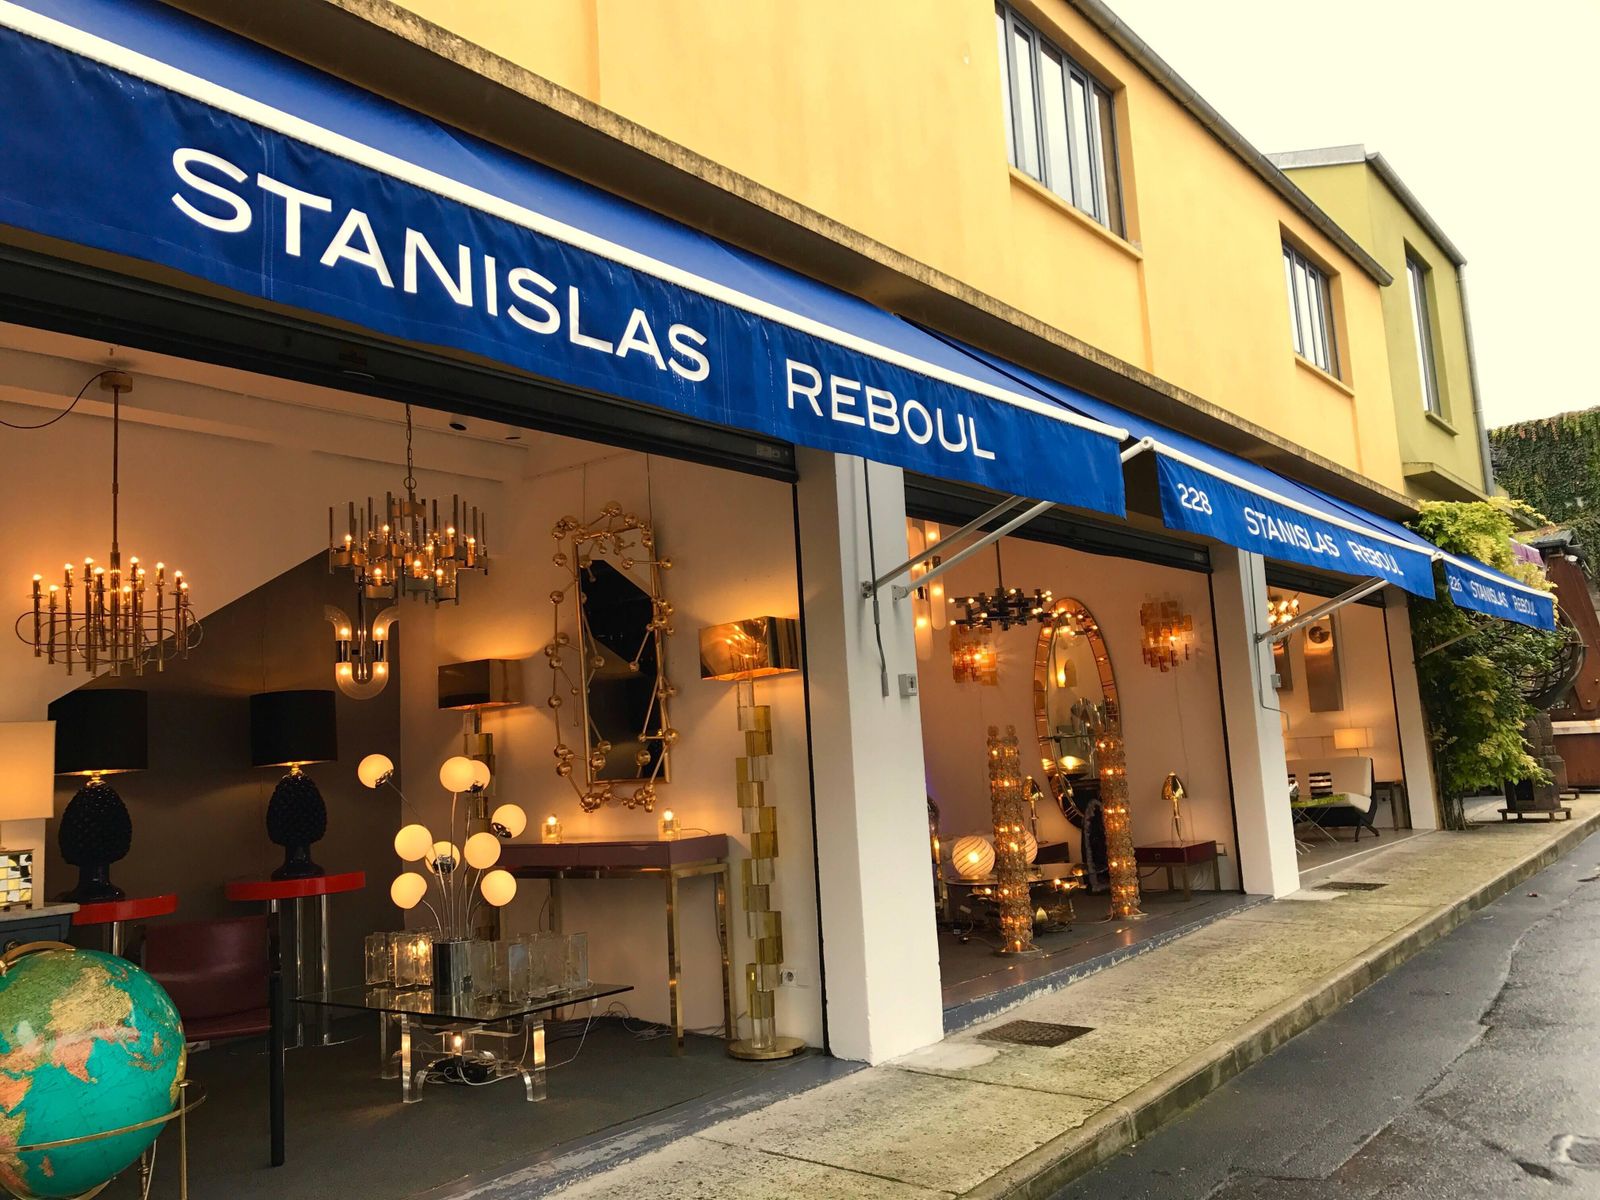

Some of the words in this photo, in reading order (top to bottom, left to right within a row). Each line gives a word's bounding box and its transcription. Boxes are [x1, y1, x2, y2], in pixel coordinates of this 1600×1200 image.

[171, 147, 711, 382] STANISLAS
[785, 358, 996, 461] REBOUL
[1177, 483, 1213, 516] 228
[1244, 507, 1340, 558] STANISLAS
[1348, 541, 1404, 576] REBOUL
[1470, 580, 1509, 608] STANISLAS
